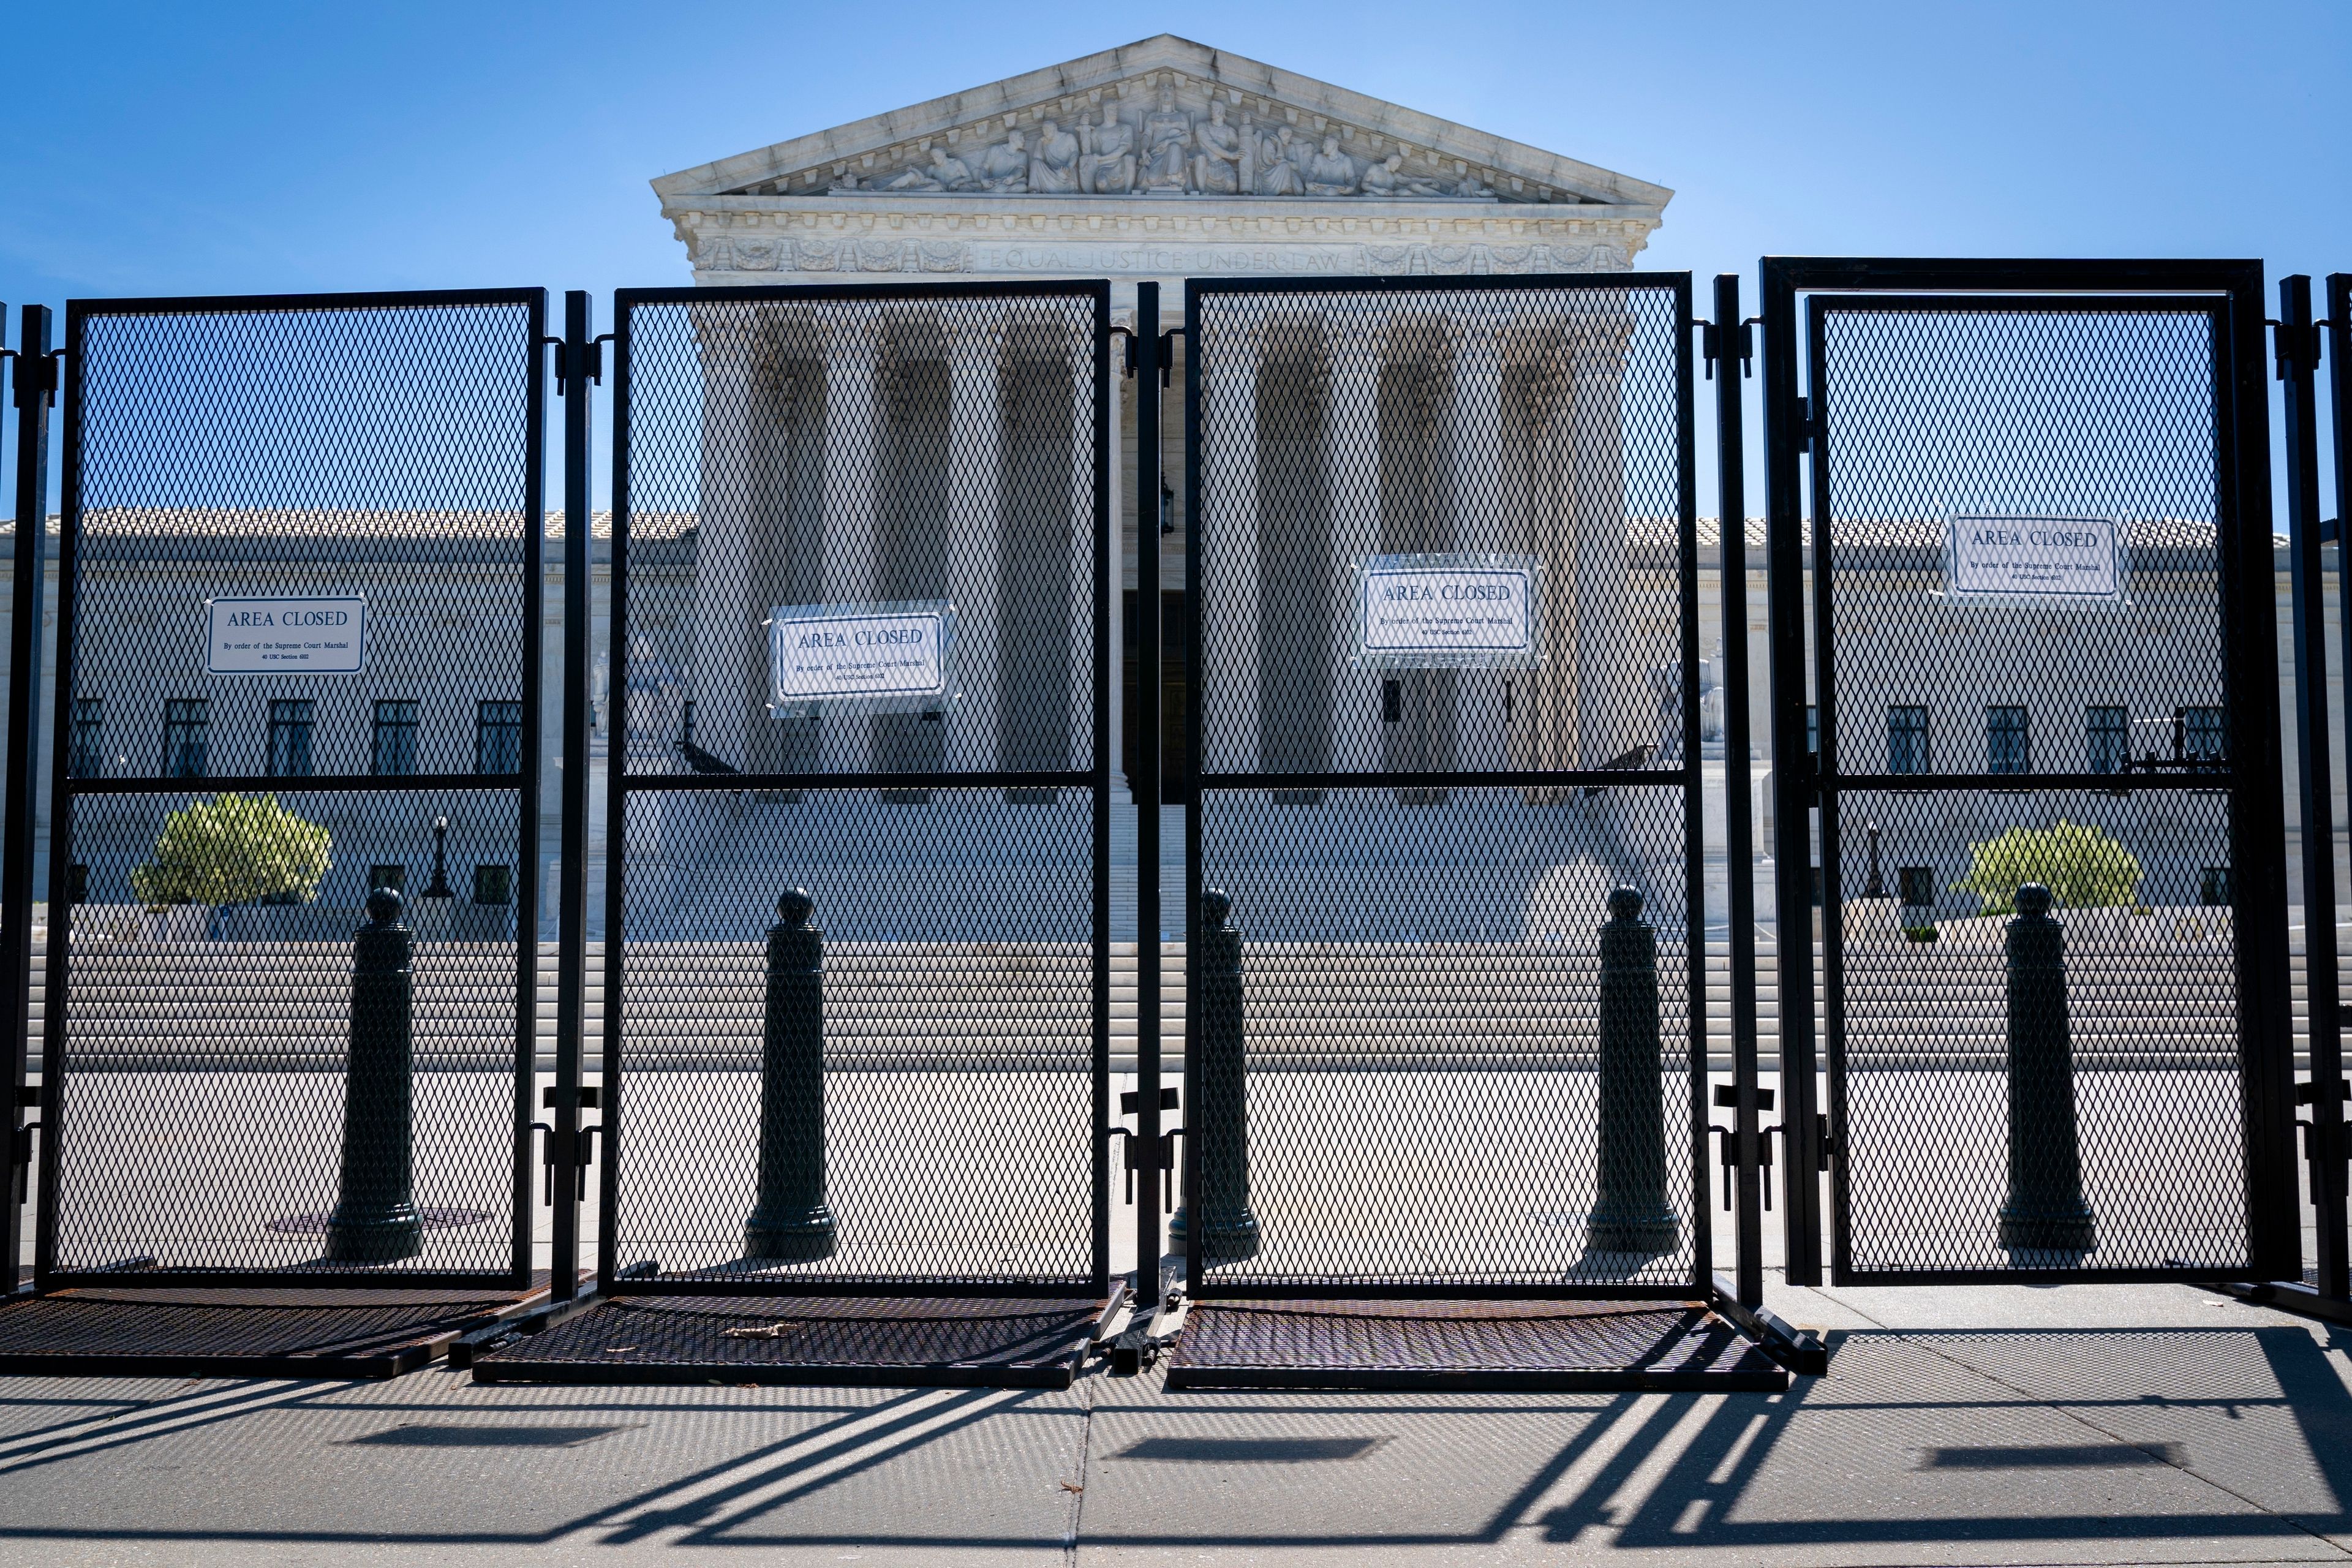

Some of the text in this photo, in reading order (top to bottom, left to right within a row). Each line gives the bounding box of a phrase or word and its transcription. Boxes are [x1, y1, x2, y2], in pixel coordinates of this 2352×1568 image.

[990, 250, 1341, 270] EQUAL JUSTICE UNDER LAW
[1972, 530, 2097, 547] AREA CLOSED
[1384, 586, 1510, 600] AREA CLOSED
[227, 611, 347, 626] AREA CLOSED
[798, 629, 922, 648] AREA CLOSED
